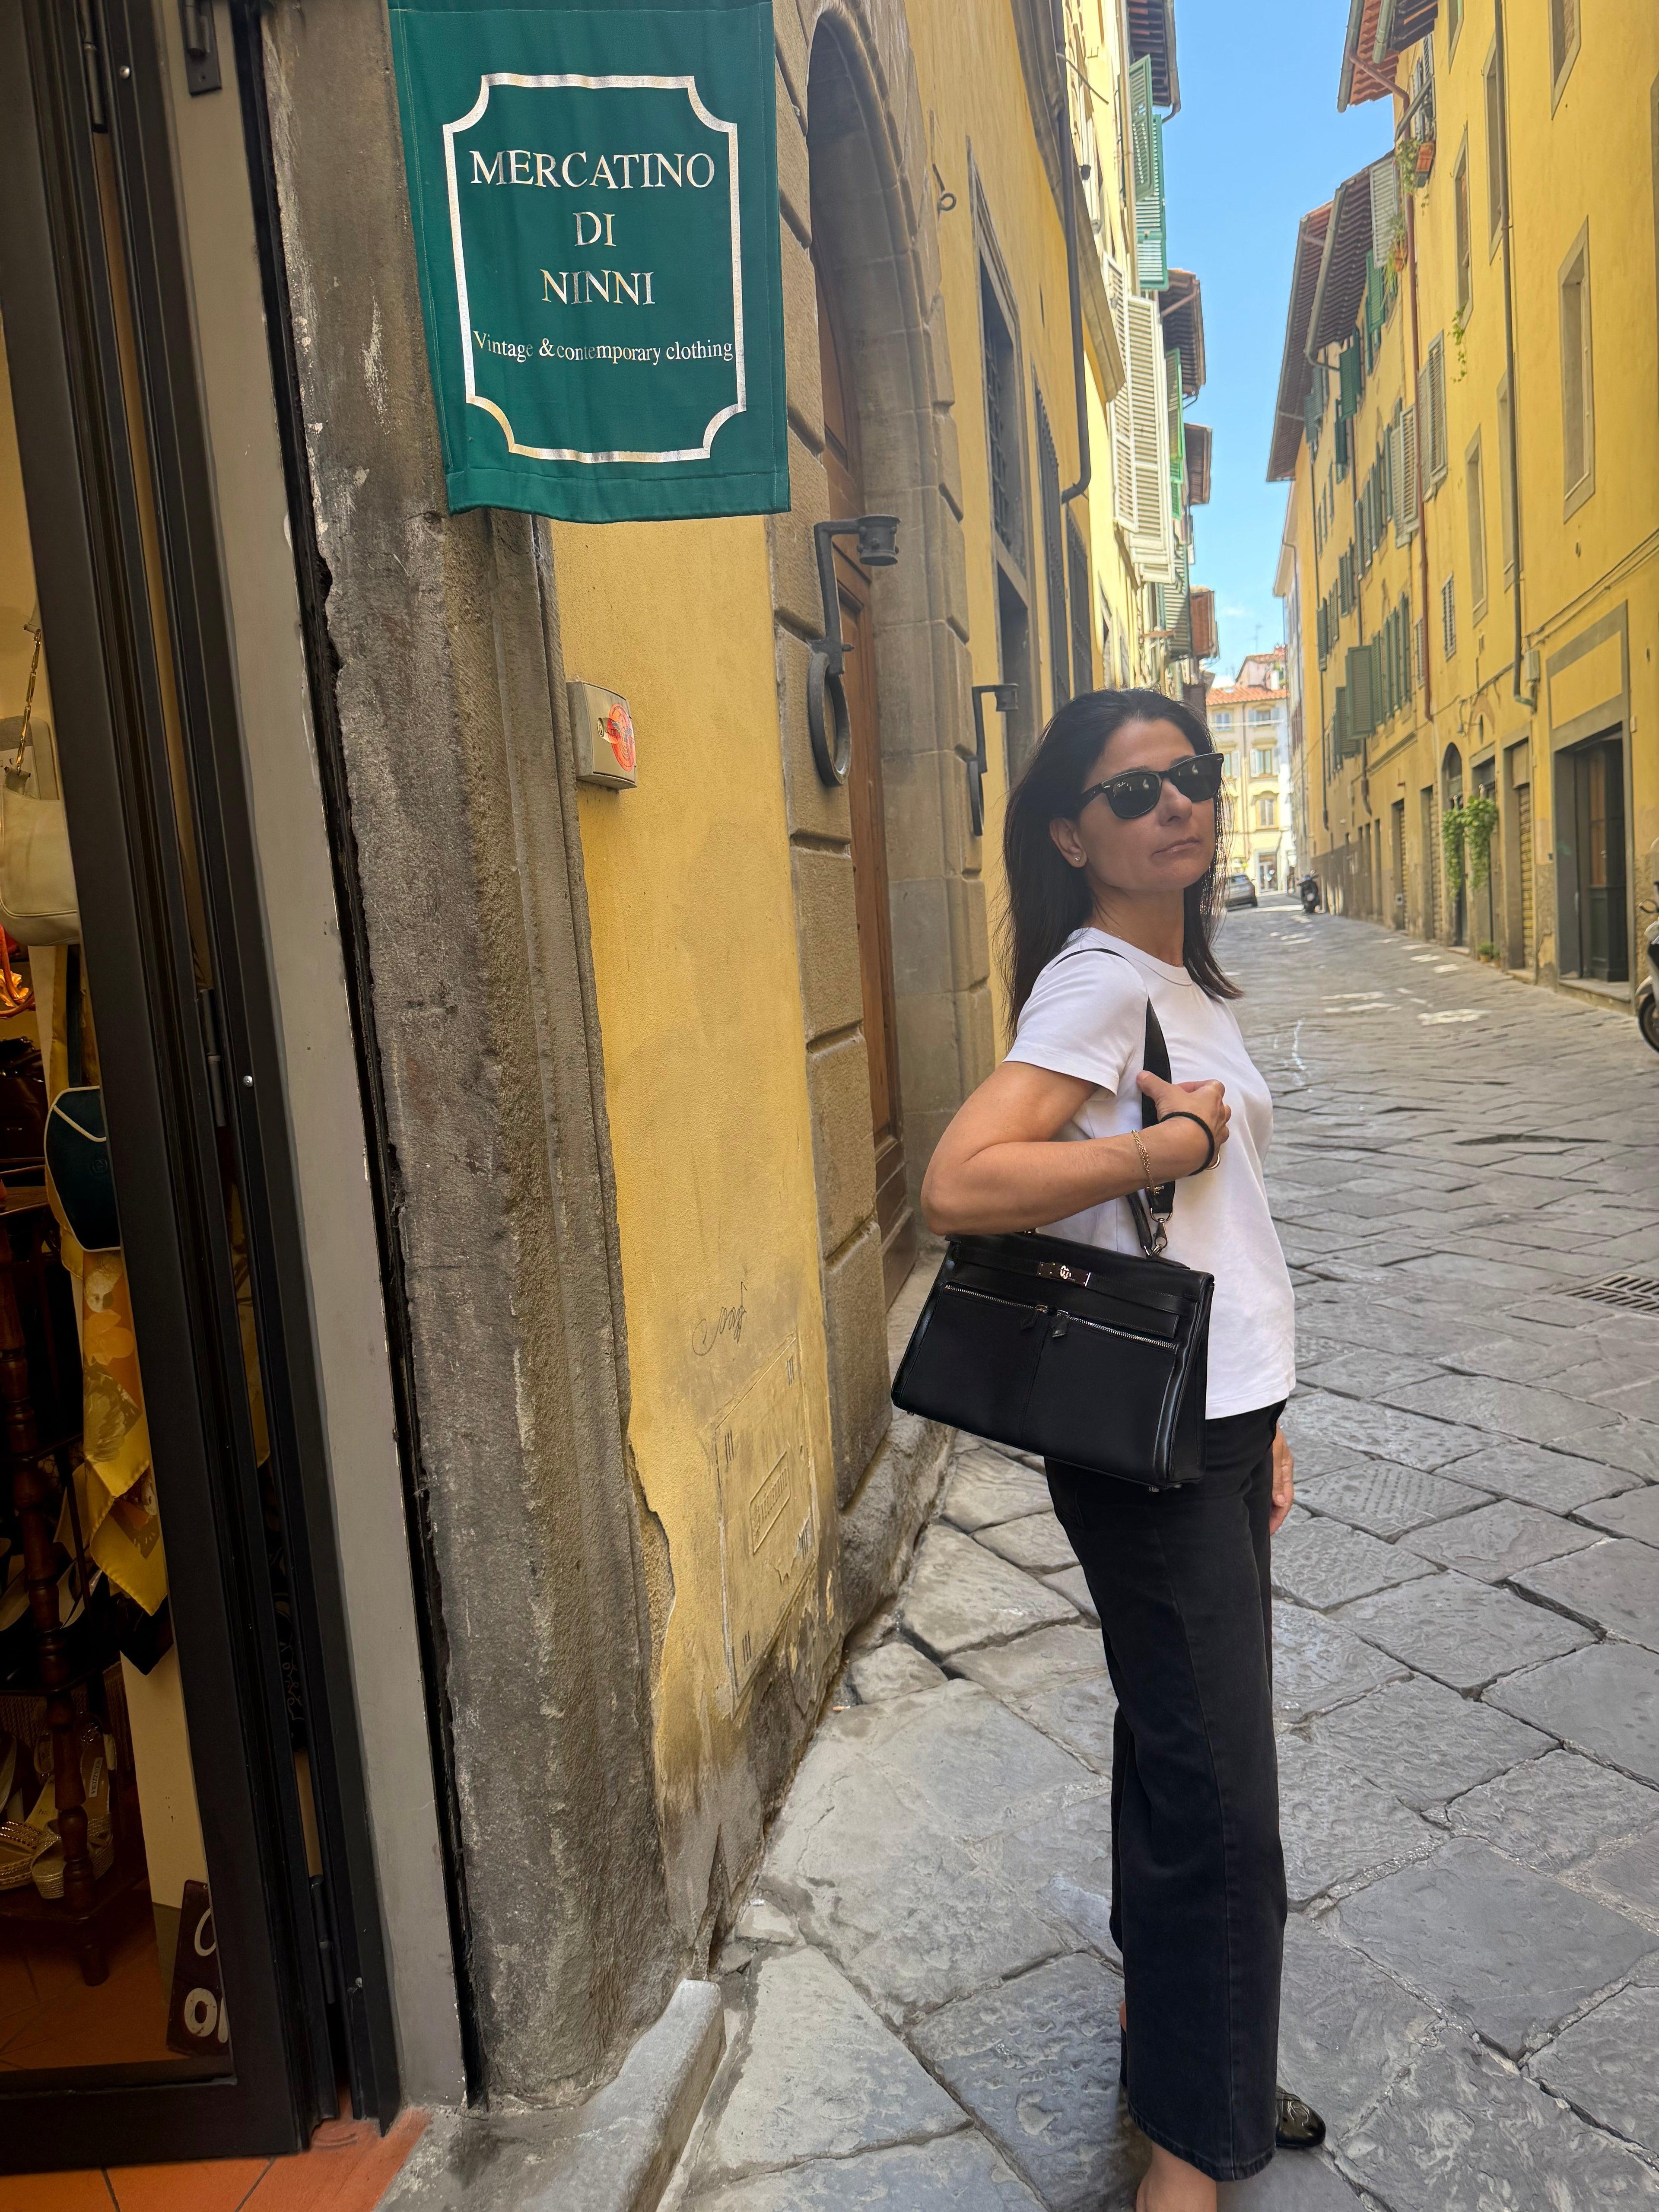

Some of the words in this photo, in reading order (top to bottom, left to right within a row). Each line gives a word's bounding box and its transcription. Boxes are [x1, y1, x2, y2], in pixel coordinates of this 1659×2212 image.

[469, 150, 714, 189] MERCATINO
[573, 212, 616, 246] DI
[540, 269, 655, 305] NINNI
[473, 331, 533, 363] Vintage
[666, 340, 733, 361] clothing
